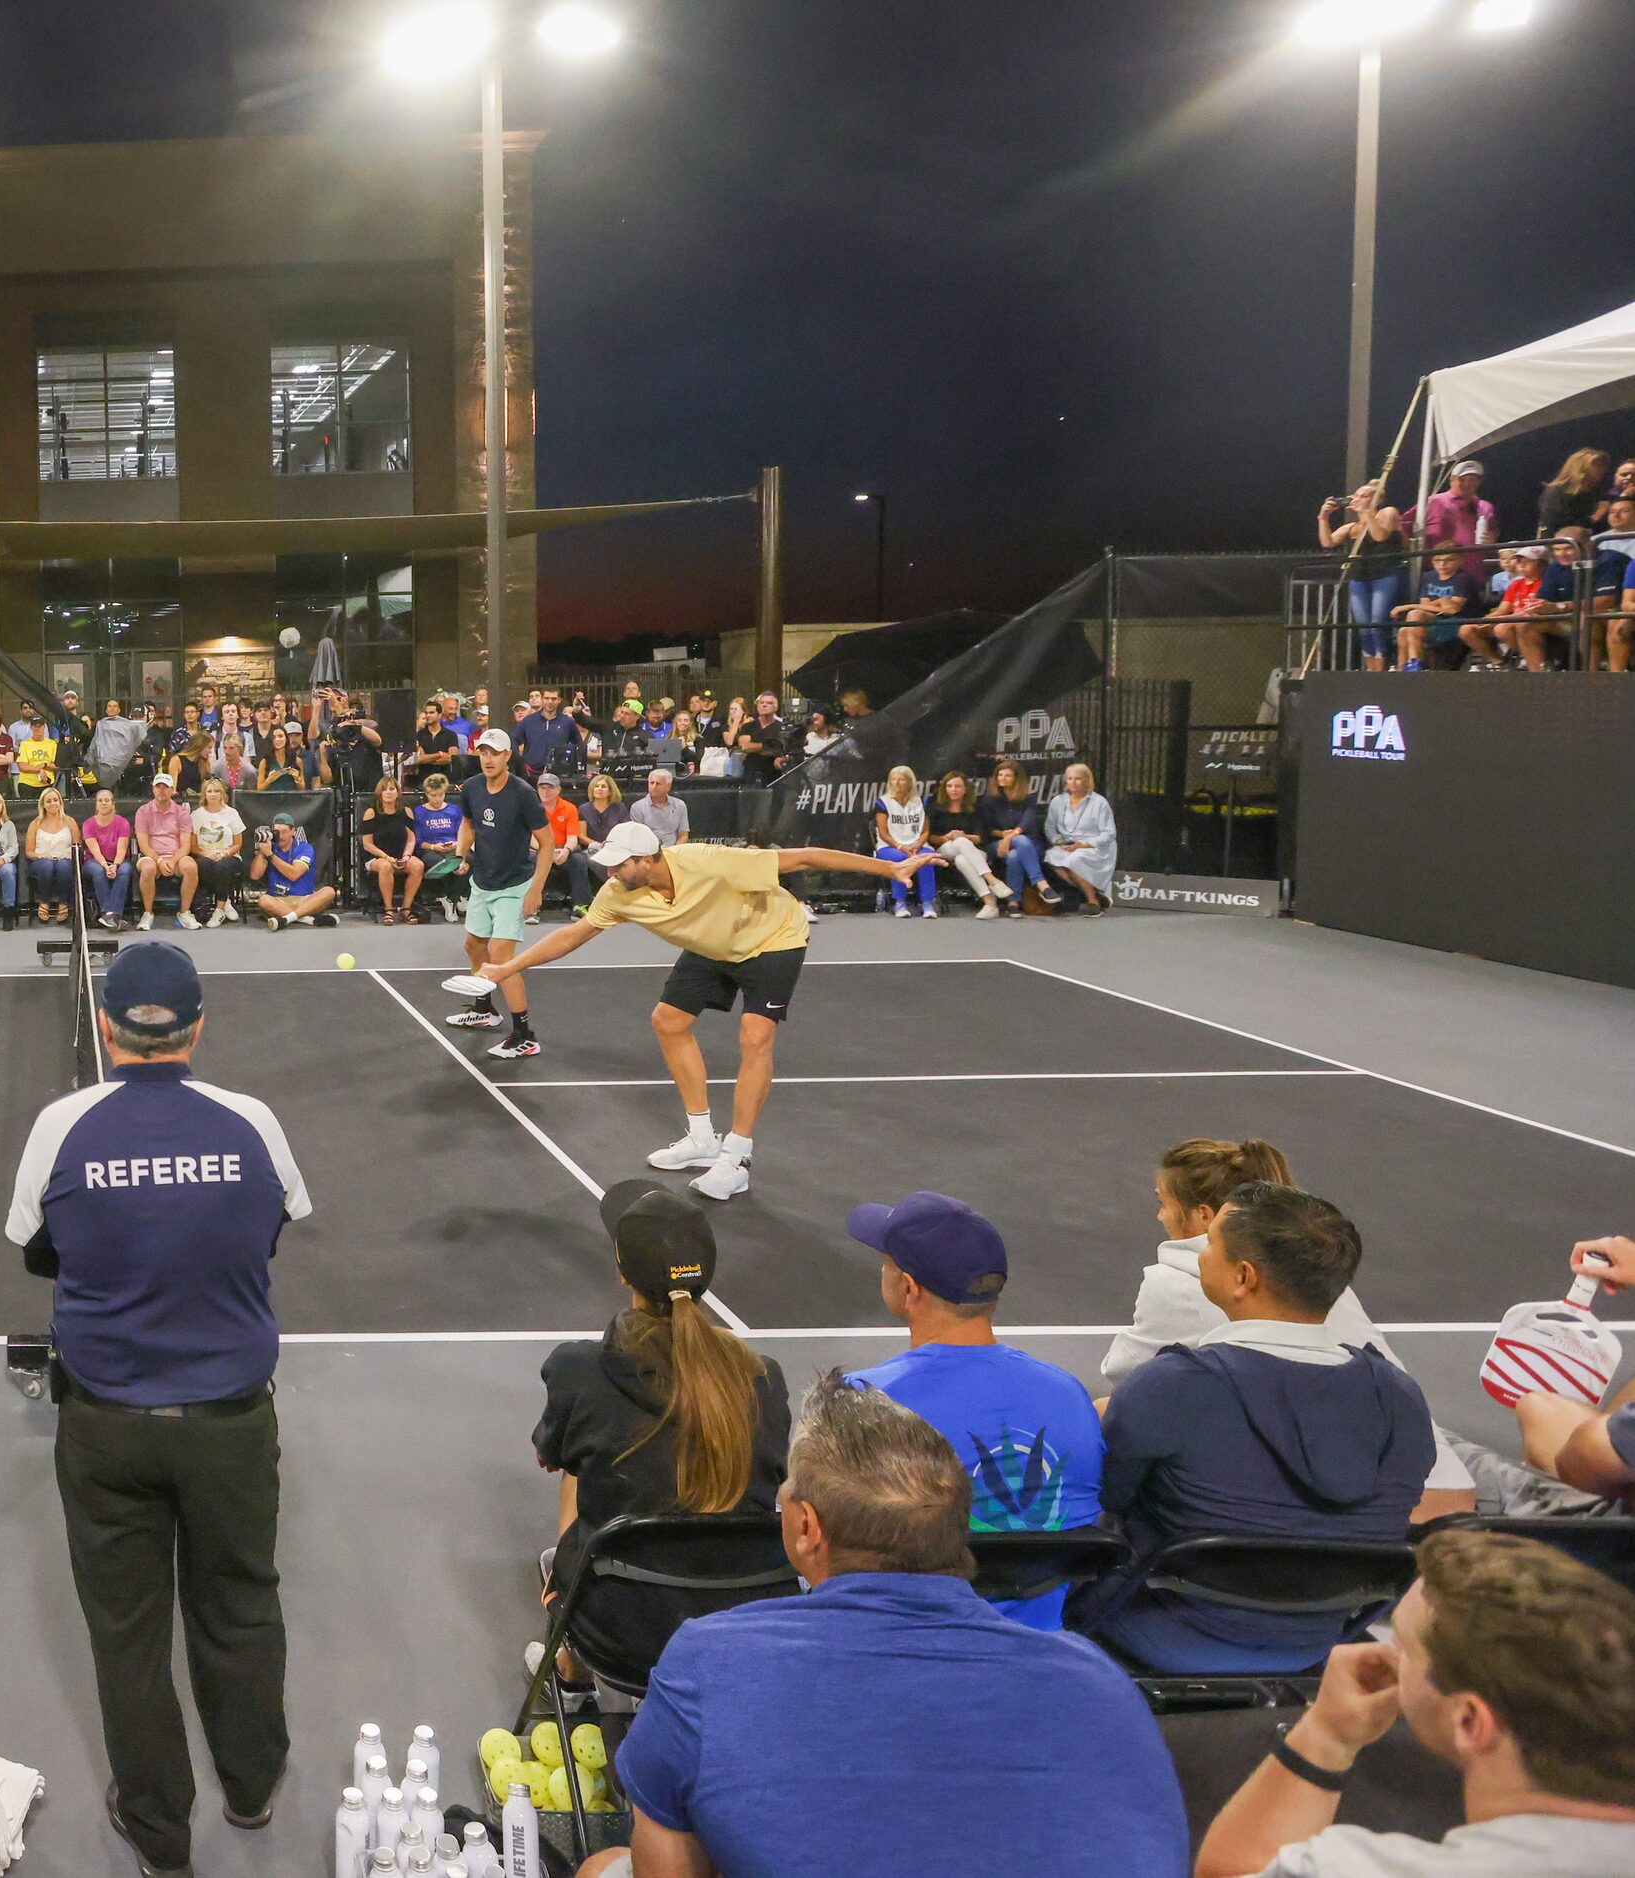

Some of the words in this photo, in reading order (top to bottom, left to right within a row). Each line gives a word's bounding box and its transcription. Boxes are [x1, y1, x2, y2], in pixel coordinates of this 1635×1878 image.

[996, 709, 1075, 752] PPA
[1332, 705, 1406, 750] PPA
[32, 749, 49, 758] PPA
[1050, 750, 1075, 759] TOUR
[1332, 749, 1380, 760] PICKLEBALL
[1380, 752, 1405, 761] TOUR
[630, 764, 654, 772] Hyperice
[796, 782, 861, 815] #PLAY
[1028, 774, 1067, 805] PLA
[891, 813, 920, 824] DALLAS
[1118, 886, 1260, 907] DRAFTKINGS
[458, 1013, 491, 1023] adidas
[84, 1154, 242, 1190] REFEREE
[670, 1264, 701, 1272] Pickleball
[511, 1825, 525, 1856] TIME
